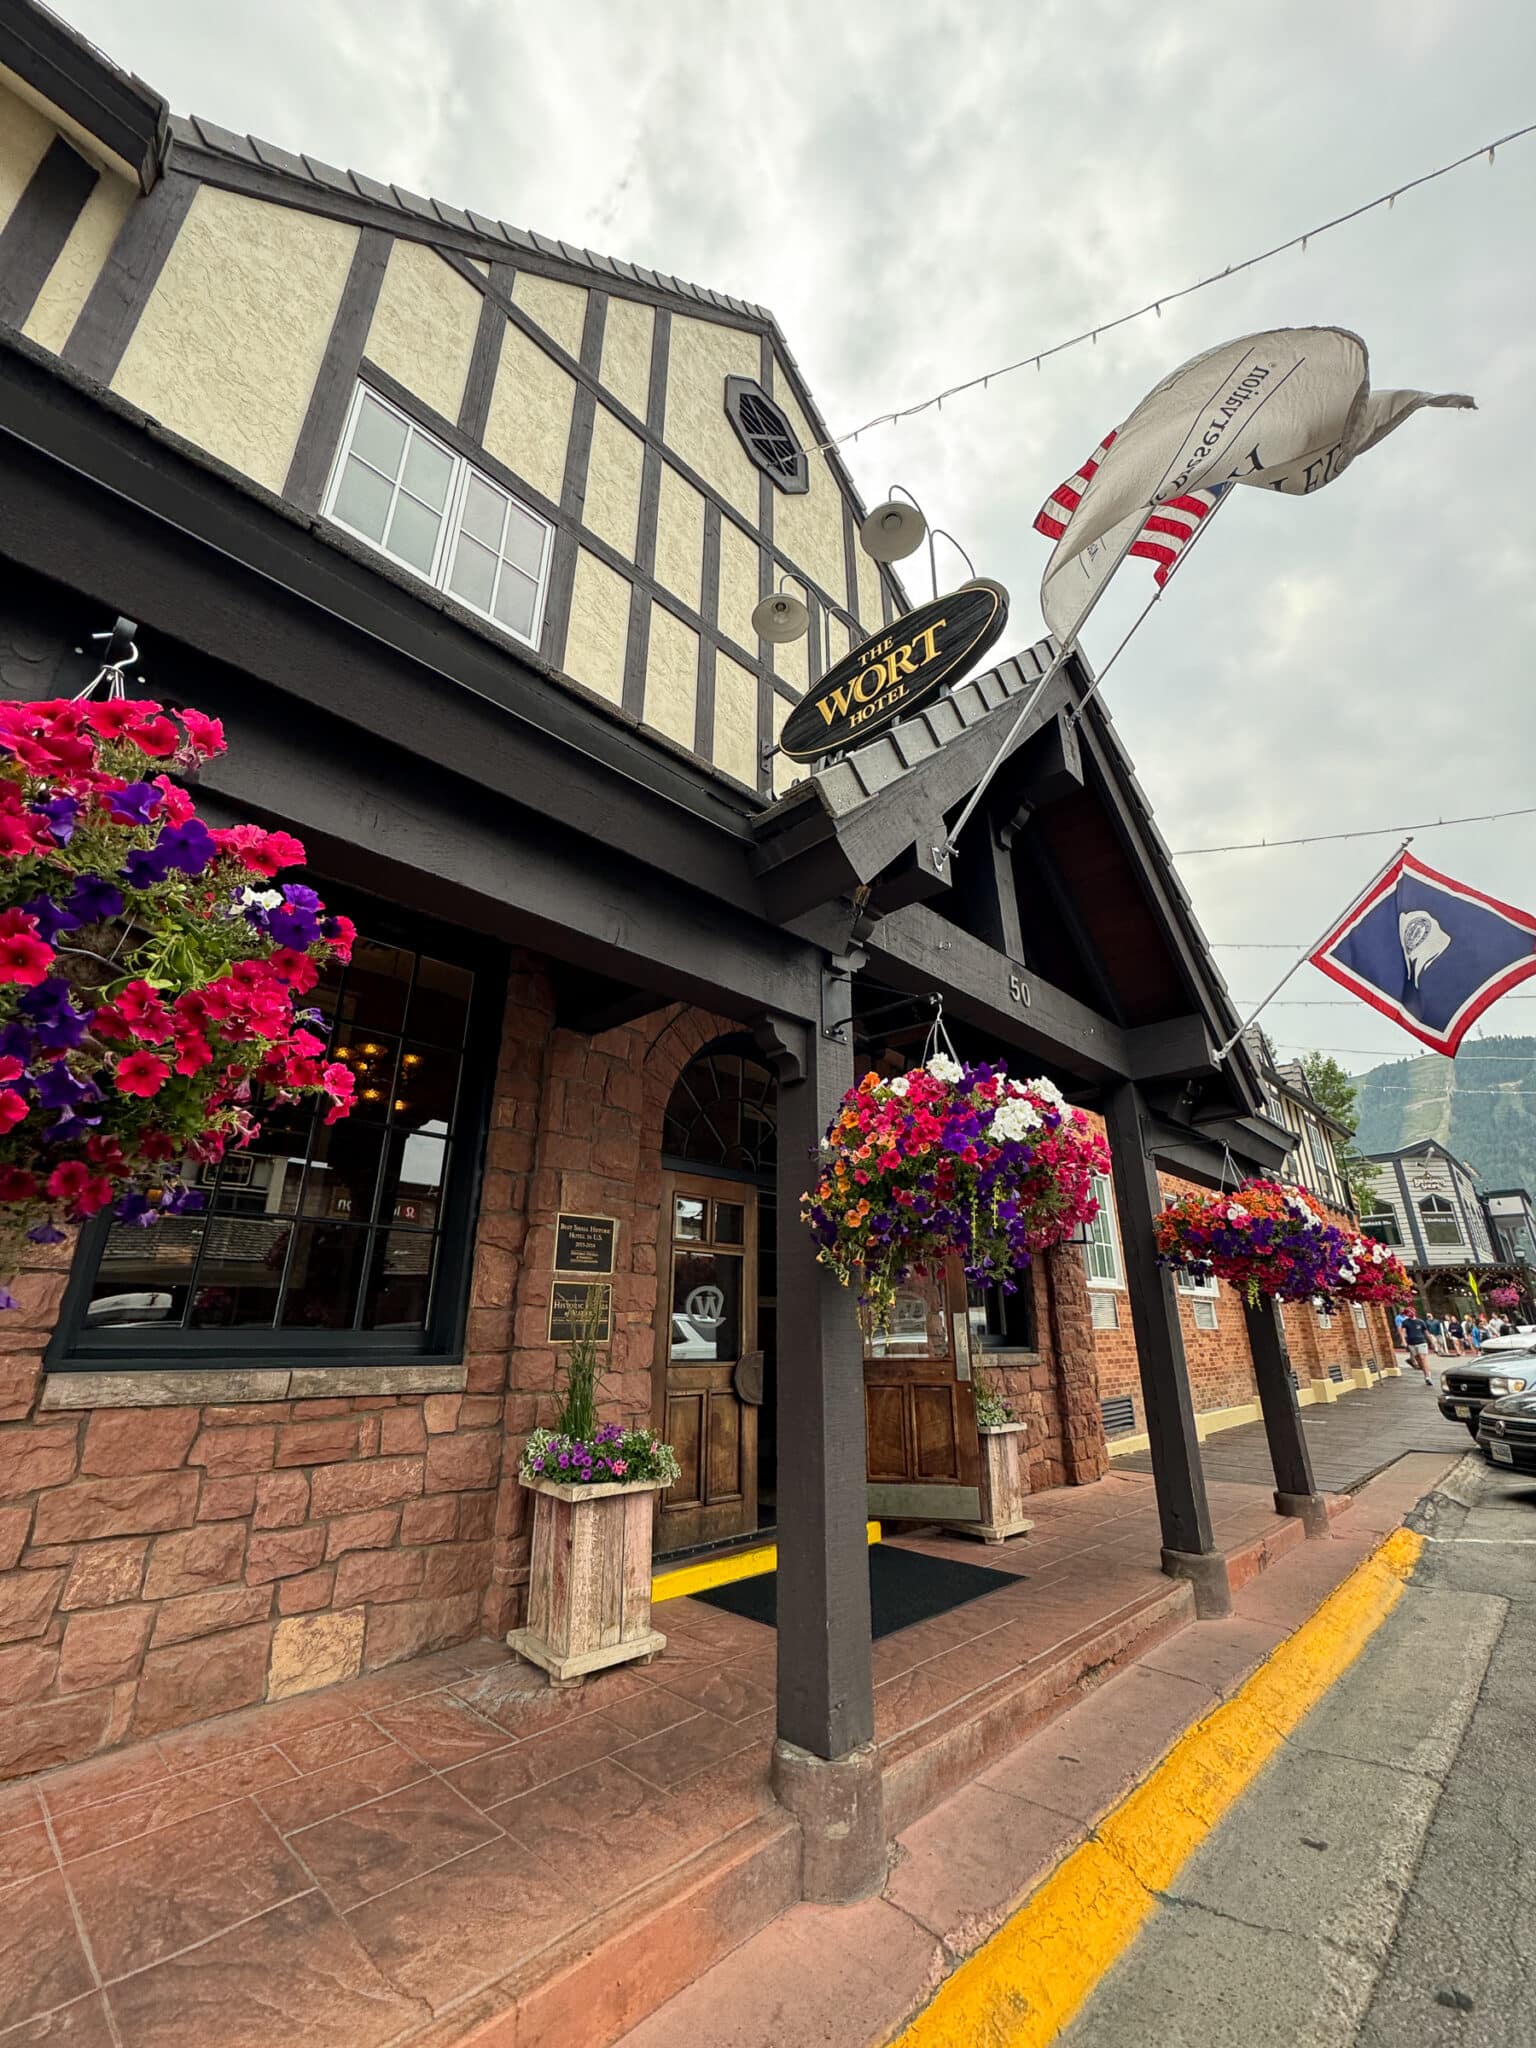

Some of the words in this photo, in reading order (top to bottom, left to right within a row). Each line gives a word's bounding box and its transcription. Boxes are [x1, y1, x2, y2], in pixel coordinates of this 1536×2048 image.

[858, 635, 895, 668] THE
[815, 619, 948, 726] WORT
[849, 684, 910, 729] HOTEL
[1010, 975, 1031, 1008] 50
